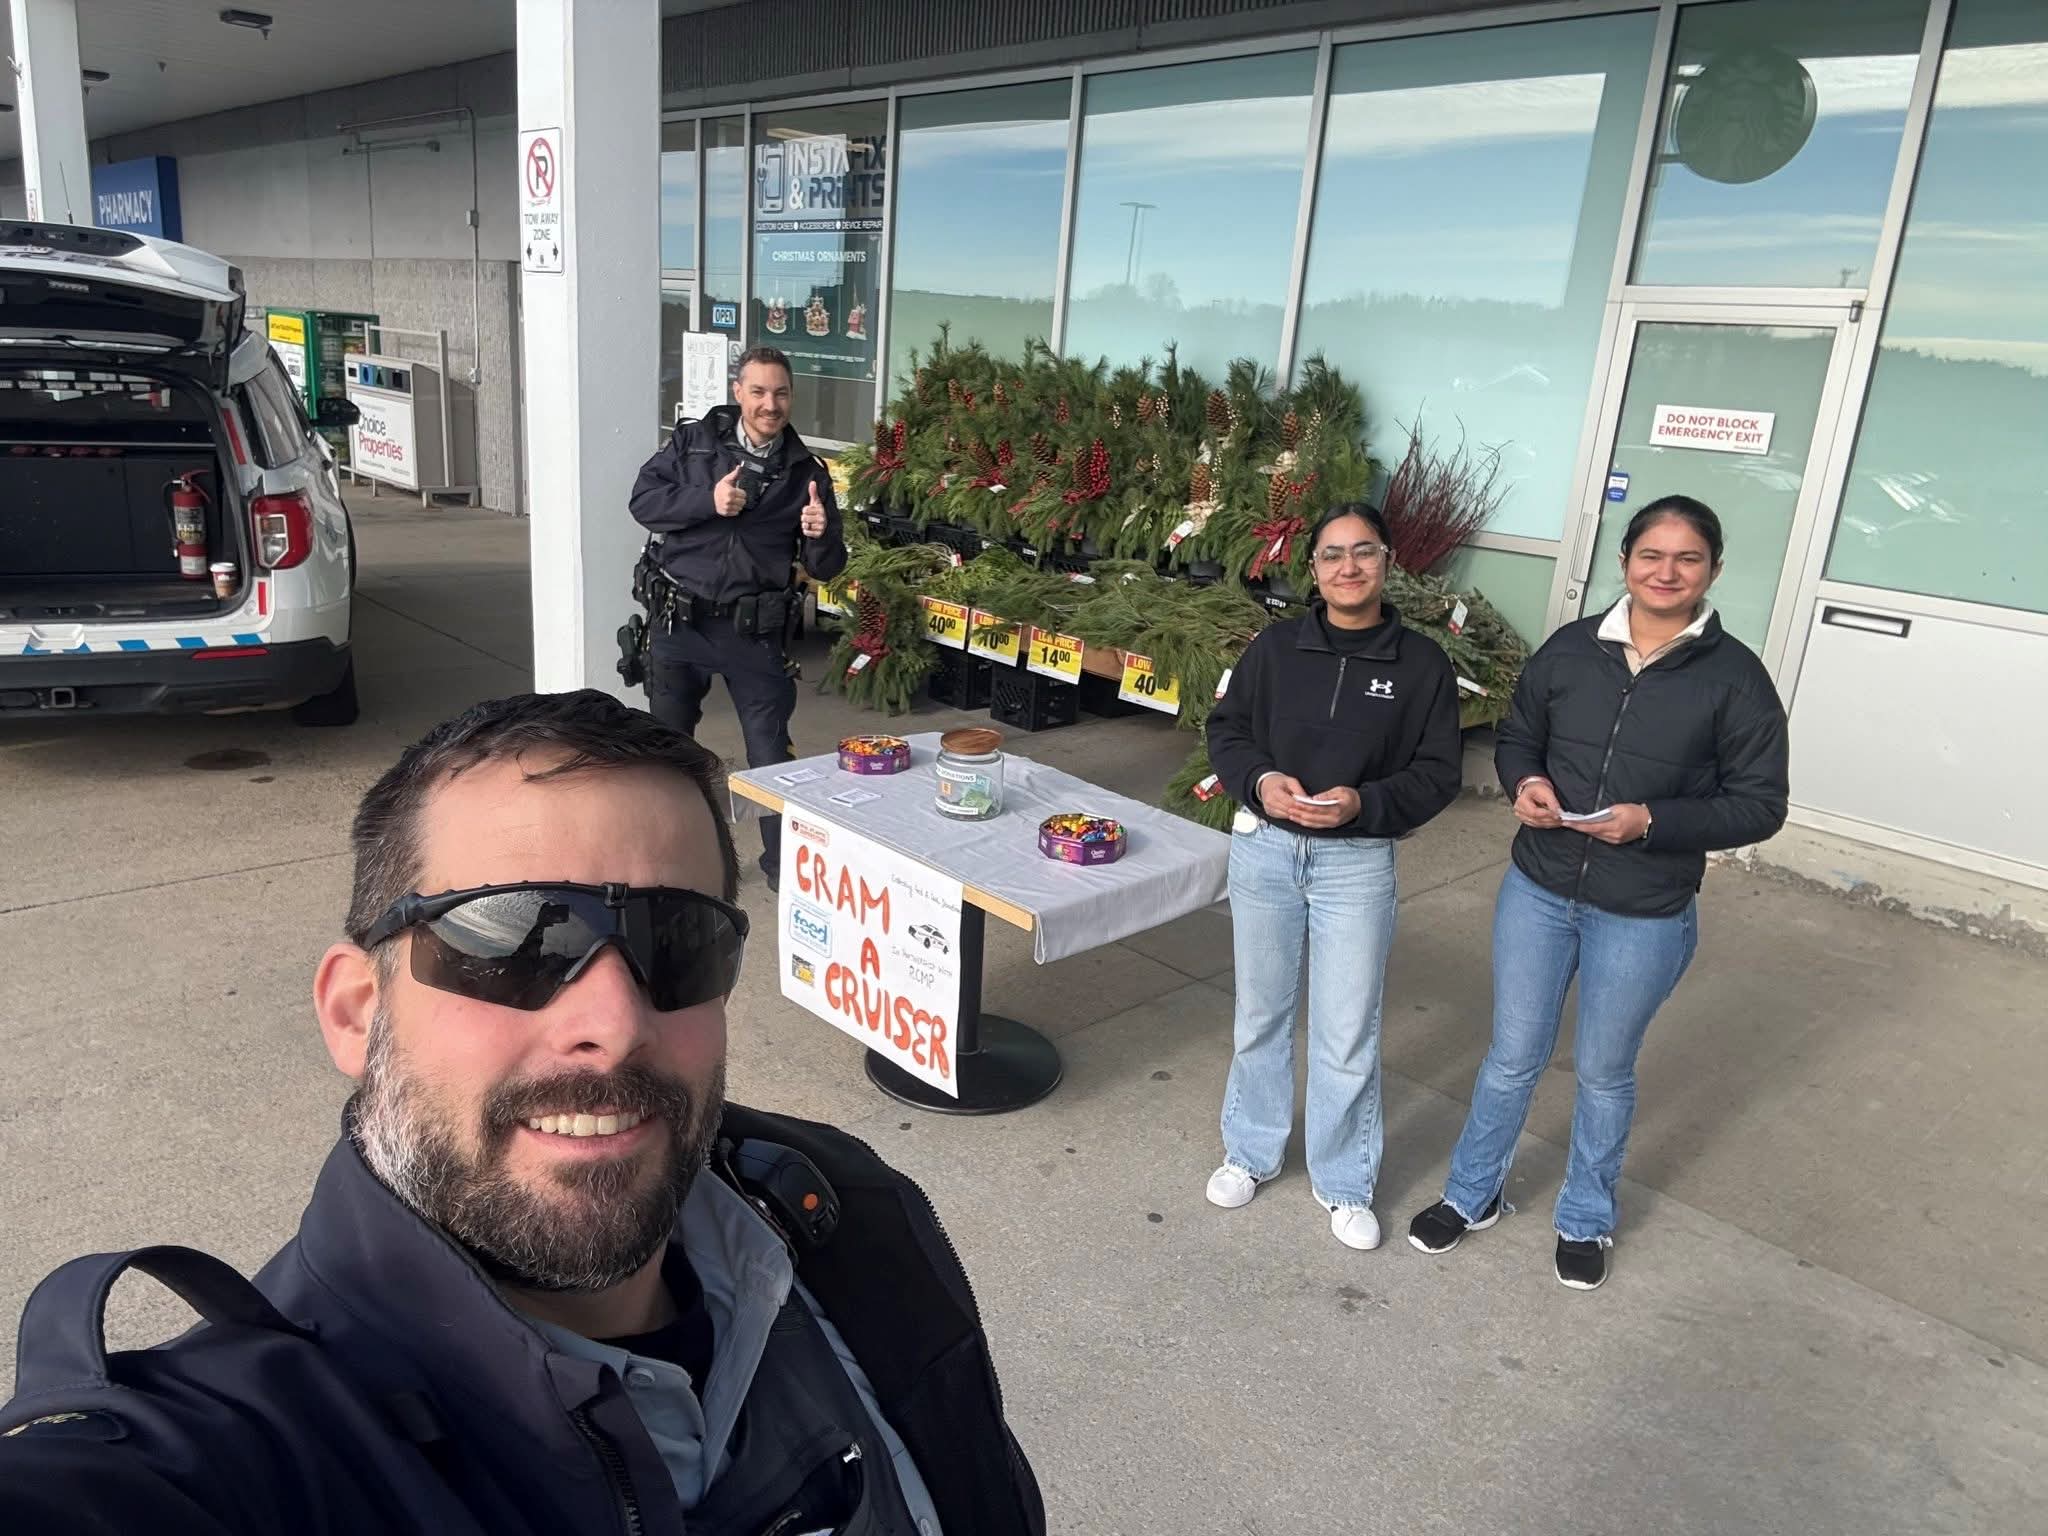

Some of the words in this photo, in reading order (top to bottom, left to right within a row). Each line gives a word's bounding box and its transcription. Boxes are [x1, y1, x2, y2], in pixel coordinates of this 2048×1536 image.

[789, 177, 804, 210] &
[98, 190, 153, 225] PHARMACY
[540, 213, 559, 225] AWAY
[533, 228, 551, 240] ZONE
[772, 251, 815, 262] CHRISTMAS
[817, 251, 867, 262] ORNAMENTS
[715, 308, 734, 323] OPEN
[1667, 413, 1686, 424] DO
[1688, 415, 1715, 427] NOT
[1717, 417, 1759, 430] BLOCK
[1658, 425, 1734, 441] EMERGENCY
[1735, 432, 1764, 444] EXIT
[359, 432, 403, 461] Properties
[1054, 635, 1077, 650] PRICE
[1133, 657, 1152, 671] LOW
[796, 844, 890, 935] CRAM
[861, 937, 880, 980] A
[825, 962, 950, 1079] CRUISER
